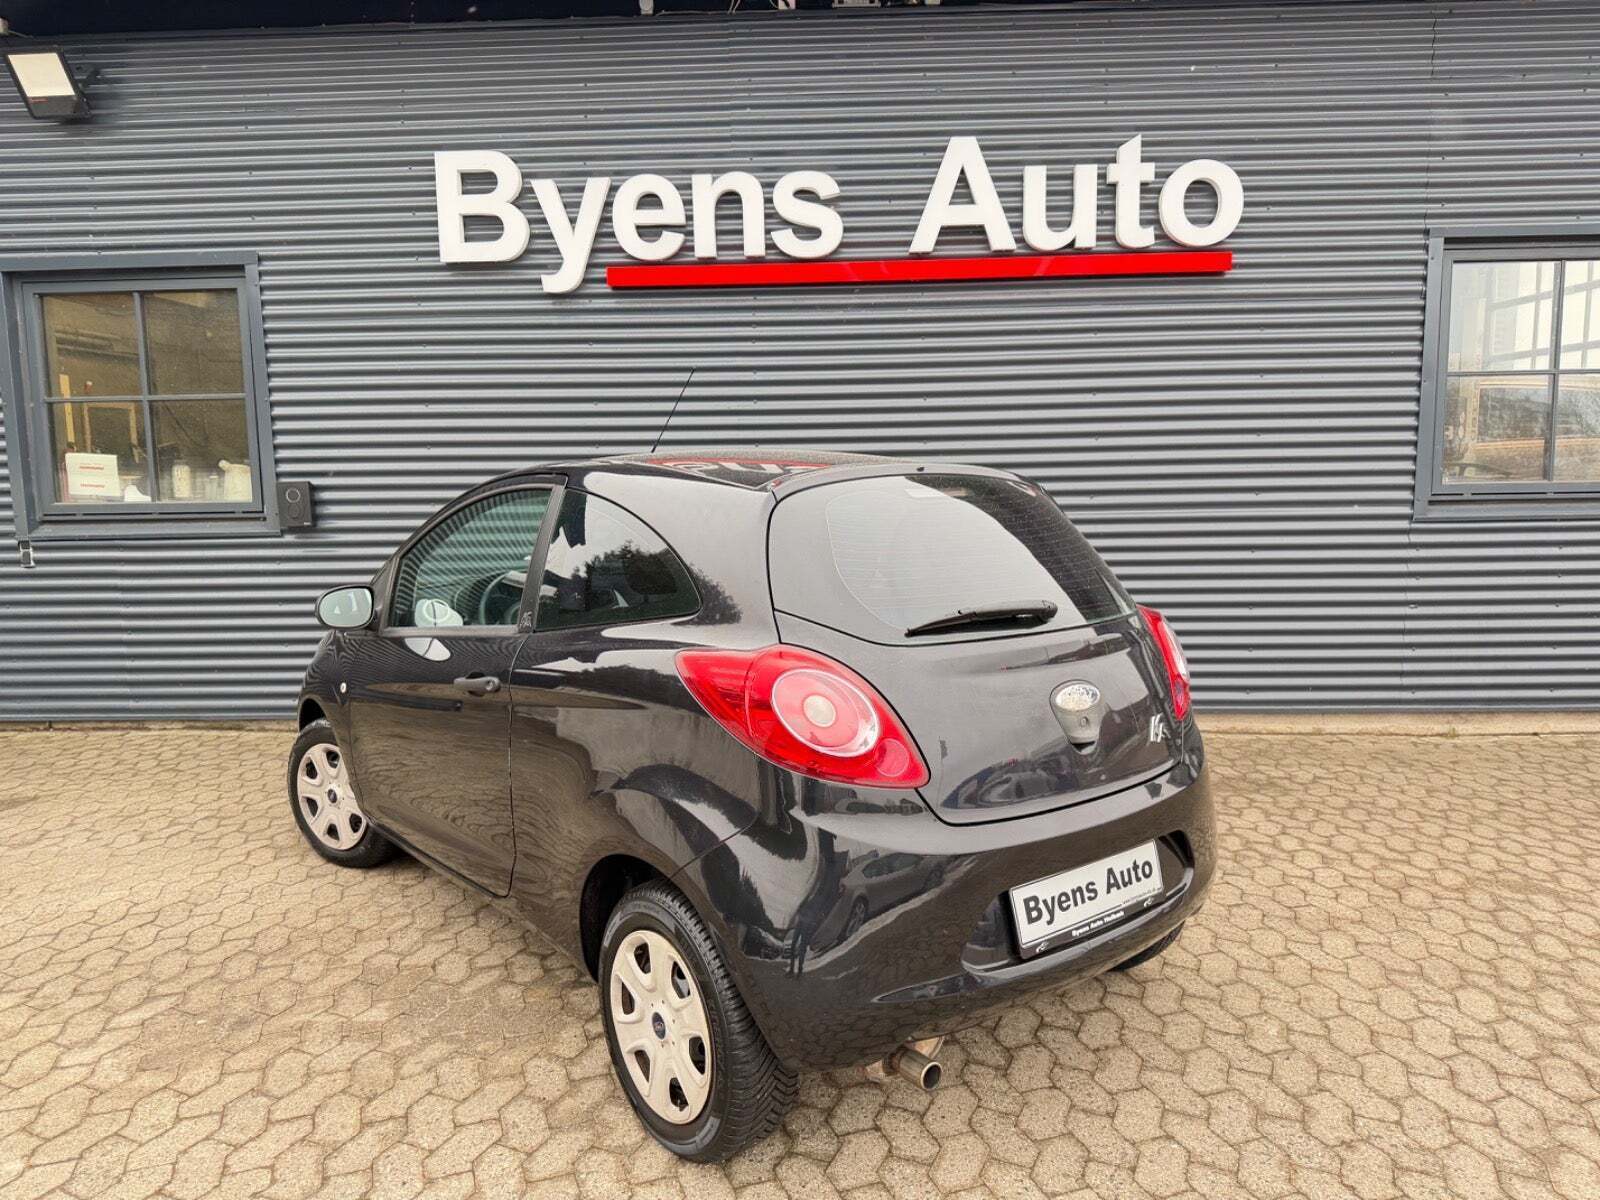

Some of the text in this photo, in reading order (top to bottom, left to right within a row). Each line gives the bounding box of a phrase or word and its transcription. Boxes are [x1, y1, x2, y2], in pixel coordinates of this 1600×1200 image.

[433, 134, 1246, 294] Byens Auto
[1022, 880, 1098, 926] Byens
[1105, 858, 1153, 895] Auto
